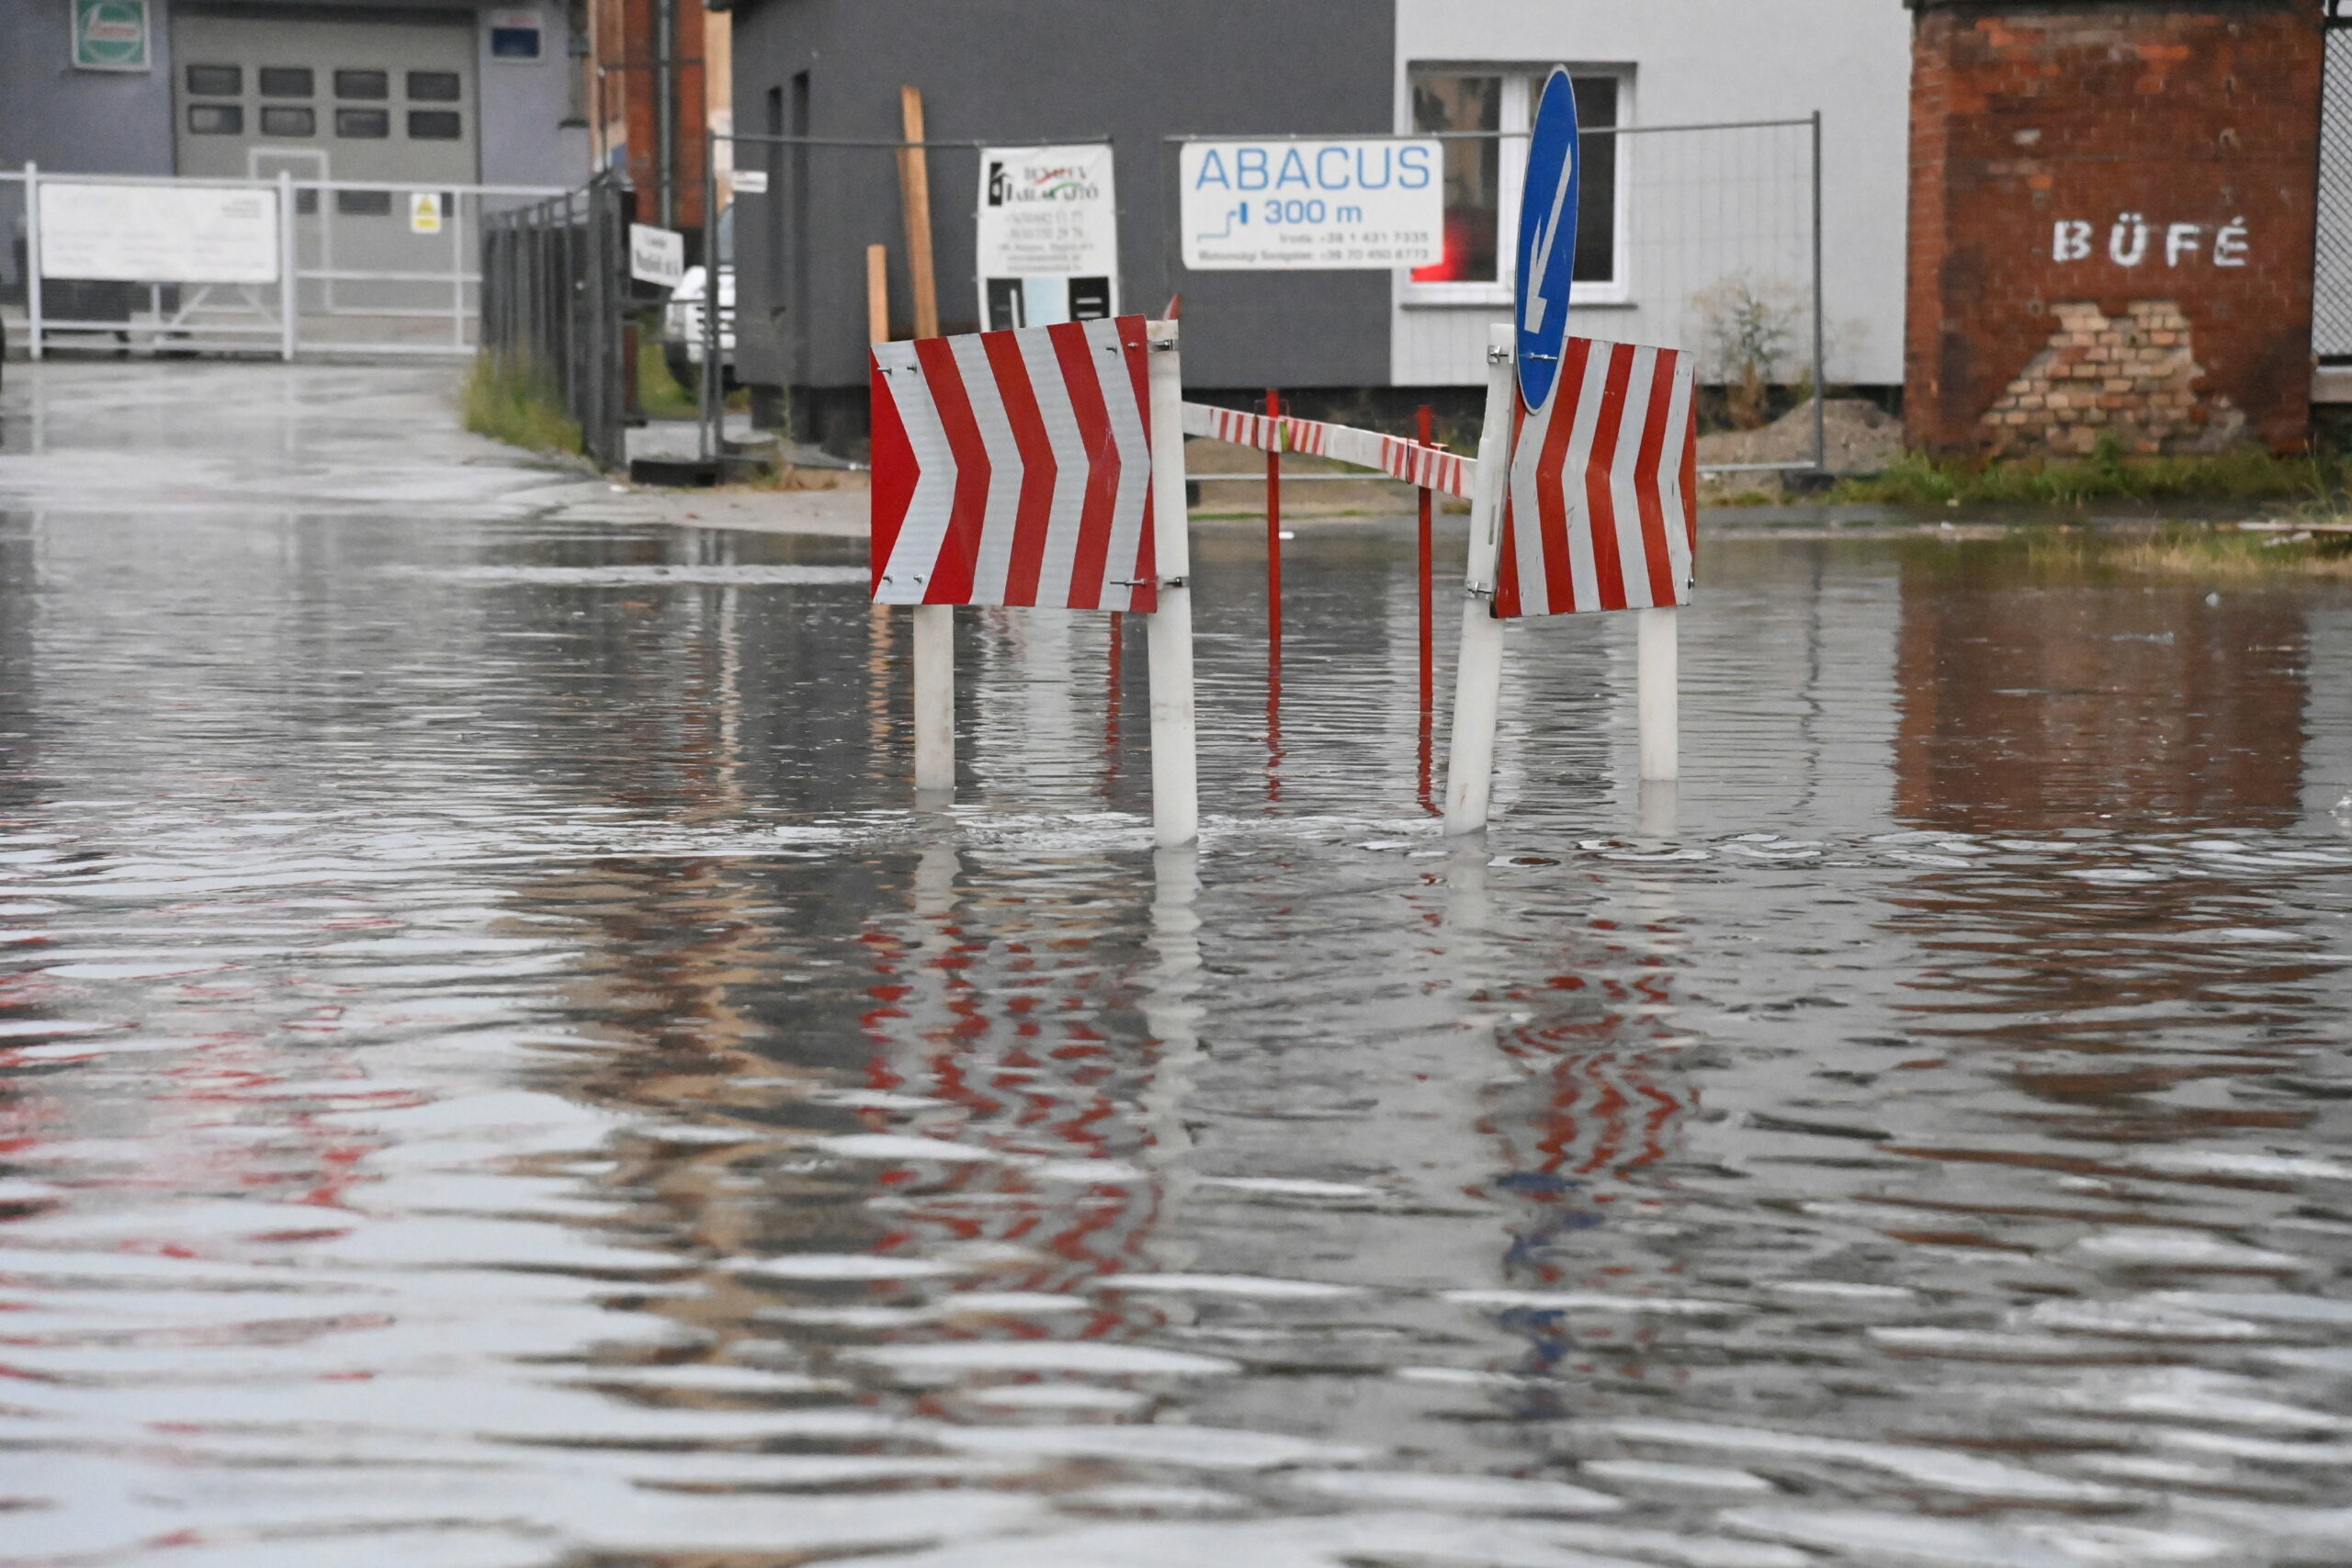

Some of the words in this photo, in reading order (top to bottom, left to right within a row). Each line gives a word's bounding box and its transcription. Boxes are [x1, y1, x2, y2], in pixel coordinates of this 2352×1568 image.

[1195, 146, 1430, 190] ABACUS
[1264, 198, 1326, 224] 300
[1336, 205, 1363, 223] m
[2052, 211, 2249, 267] BÜFÉ
